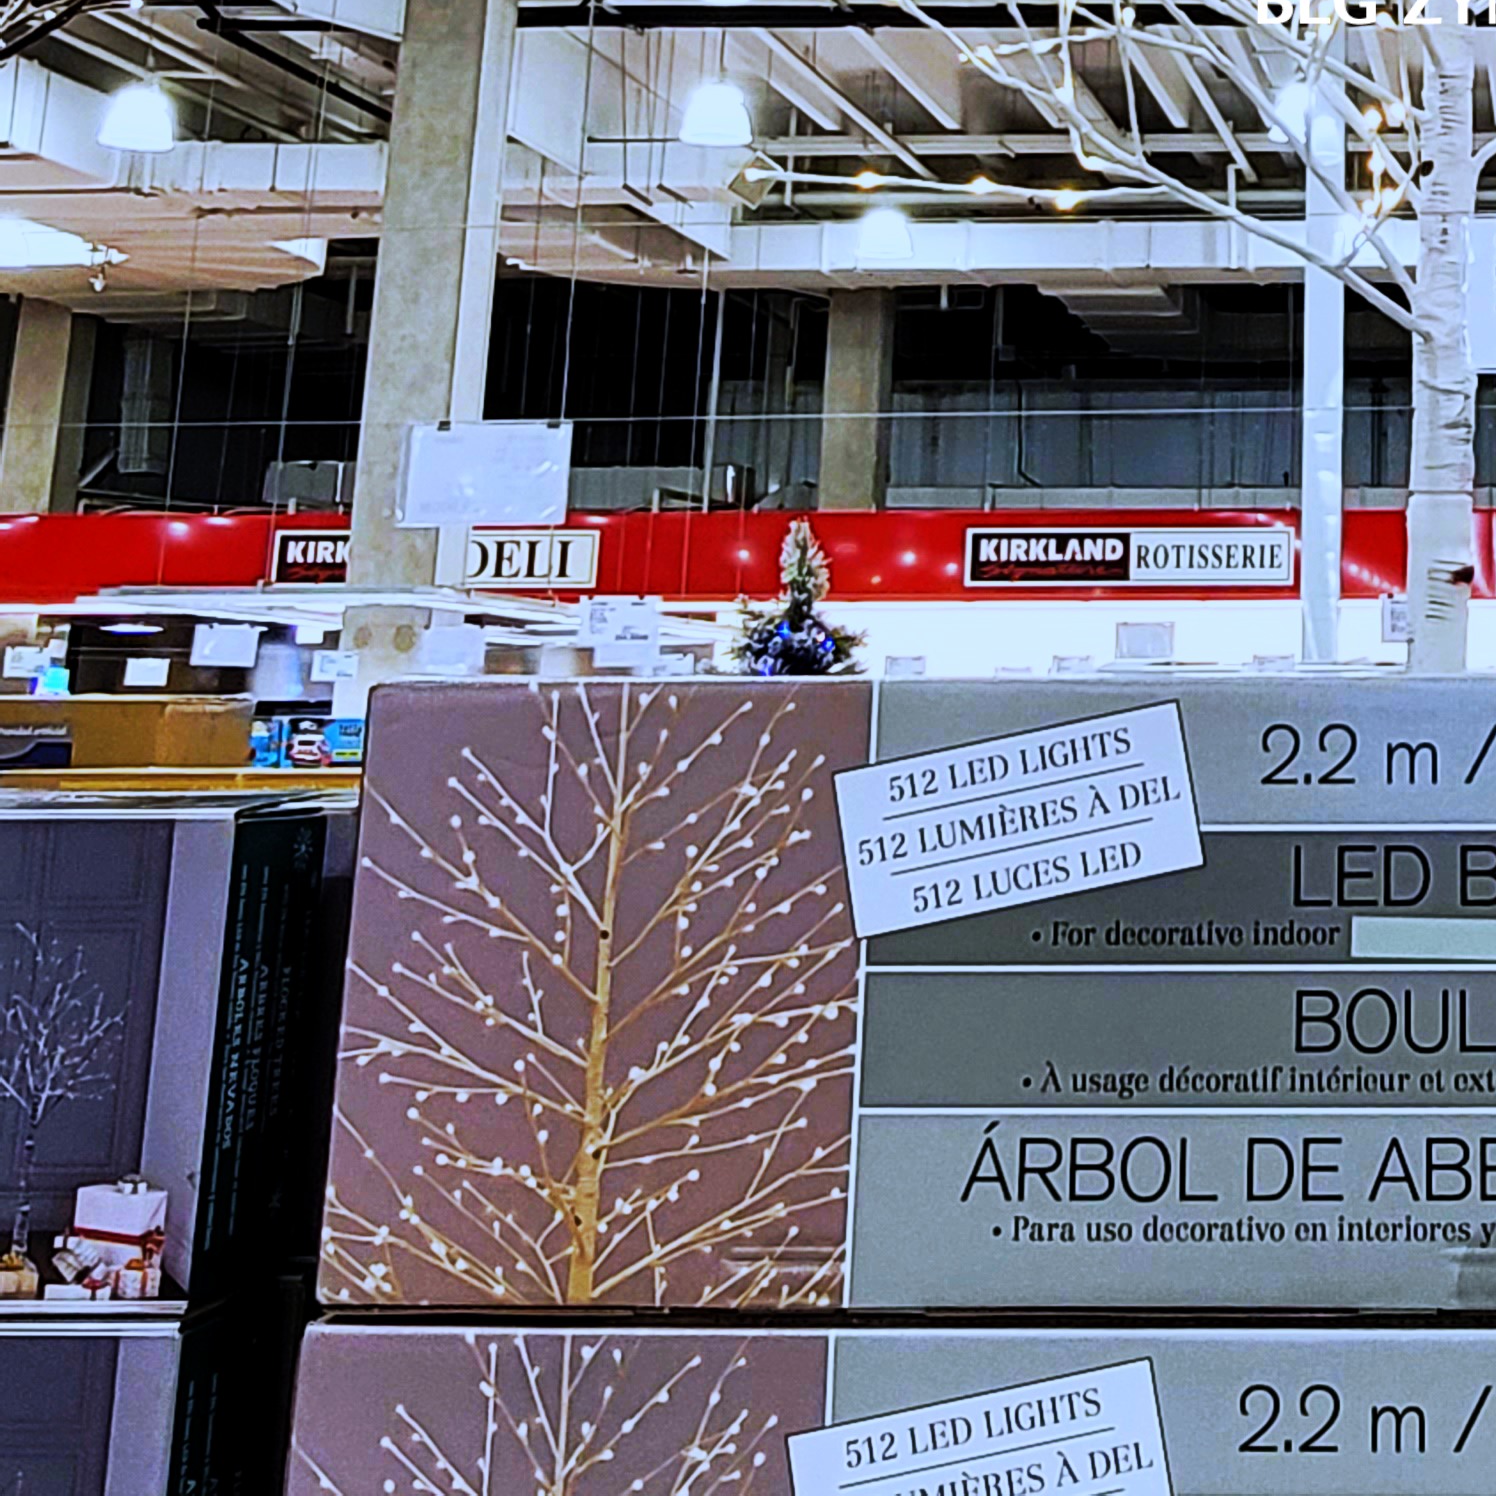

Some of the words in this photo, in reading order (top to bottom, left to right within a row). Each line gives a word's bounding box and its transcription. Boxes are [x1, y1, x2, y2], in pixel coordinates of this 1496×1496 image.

[979, 538, 1124, 562] KIRKLAND
[1136, 544, 1283, 570] ROTISSERIE
[888, 768, 939, 803] 512
[948, 754, 1010, 789] LED
[1019, 727, 1131, 775] LIGHTS
[1260, 723, 1357, 785] 2.2
[1386, 739, 1438, 785] m
[857, 832, 909, 867] 512
[917, 796, 1078, 854] LUMIÈRES
[1088, 785, 1112, 819] À
[1119, 775, 1181, 812] DEL
[912, 878, 963, 914] 512
[973, 854, 1072, 901] LUCES
[1080, 841, 1142, 878] LED
[1292, 844, 1431, 907] LED
[1051, 921, 1096, 947] For
[1104, 921, 1244, 947] decorative
[1252, 920, 1341, 946] indoor
[1040, 1061, 1062, 1093] À
[1072, 1073, 1149, 1099] usage
[1159, 1065, 1281, 1093] décoratif
[1289, 1066, 1410, 1093] intérieur
[1420, 1067, 1445, 1093] et
[960, 1121, 1218, 1202] ÁRBOL
[1246, 1136, 1343, 1202] DE
[1011, 1215, 1075, 1242] Para
[1085, 1222, 1133, 1242] uso
[1142, 1215, 1286, 1242] decorativo
[1295, 1222, 1327, 1241] en
[1337, 1215, 1472, 1242] interiores
[1480, 1222, 1496, 1248] y
[845, 1432, 898, 1469] 512
[908, 1415, 972, 1455] LED
[984, 1387, 1102, 1440] LIGHTS
[1237, 1384, 1341, 1453] 2.2
[1370, 1406, 1426, 1453] m
[1453, 1385, 1493, 1454] /
[1057, 1450, 1079, 1487] À
[1089, 1442, 1154, 1480] DEL
